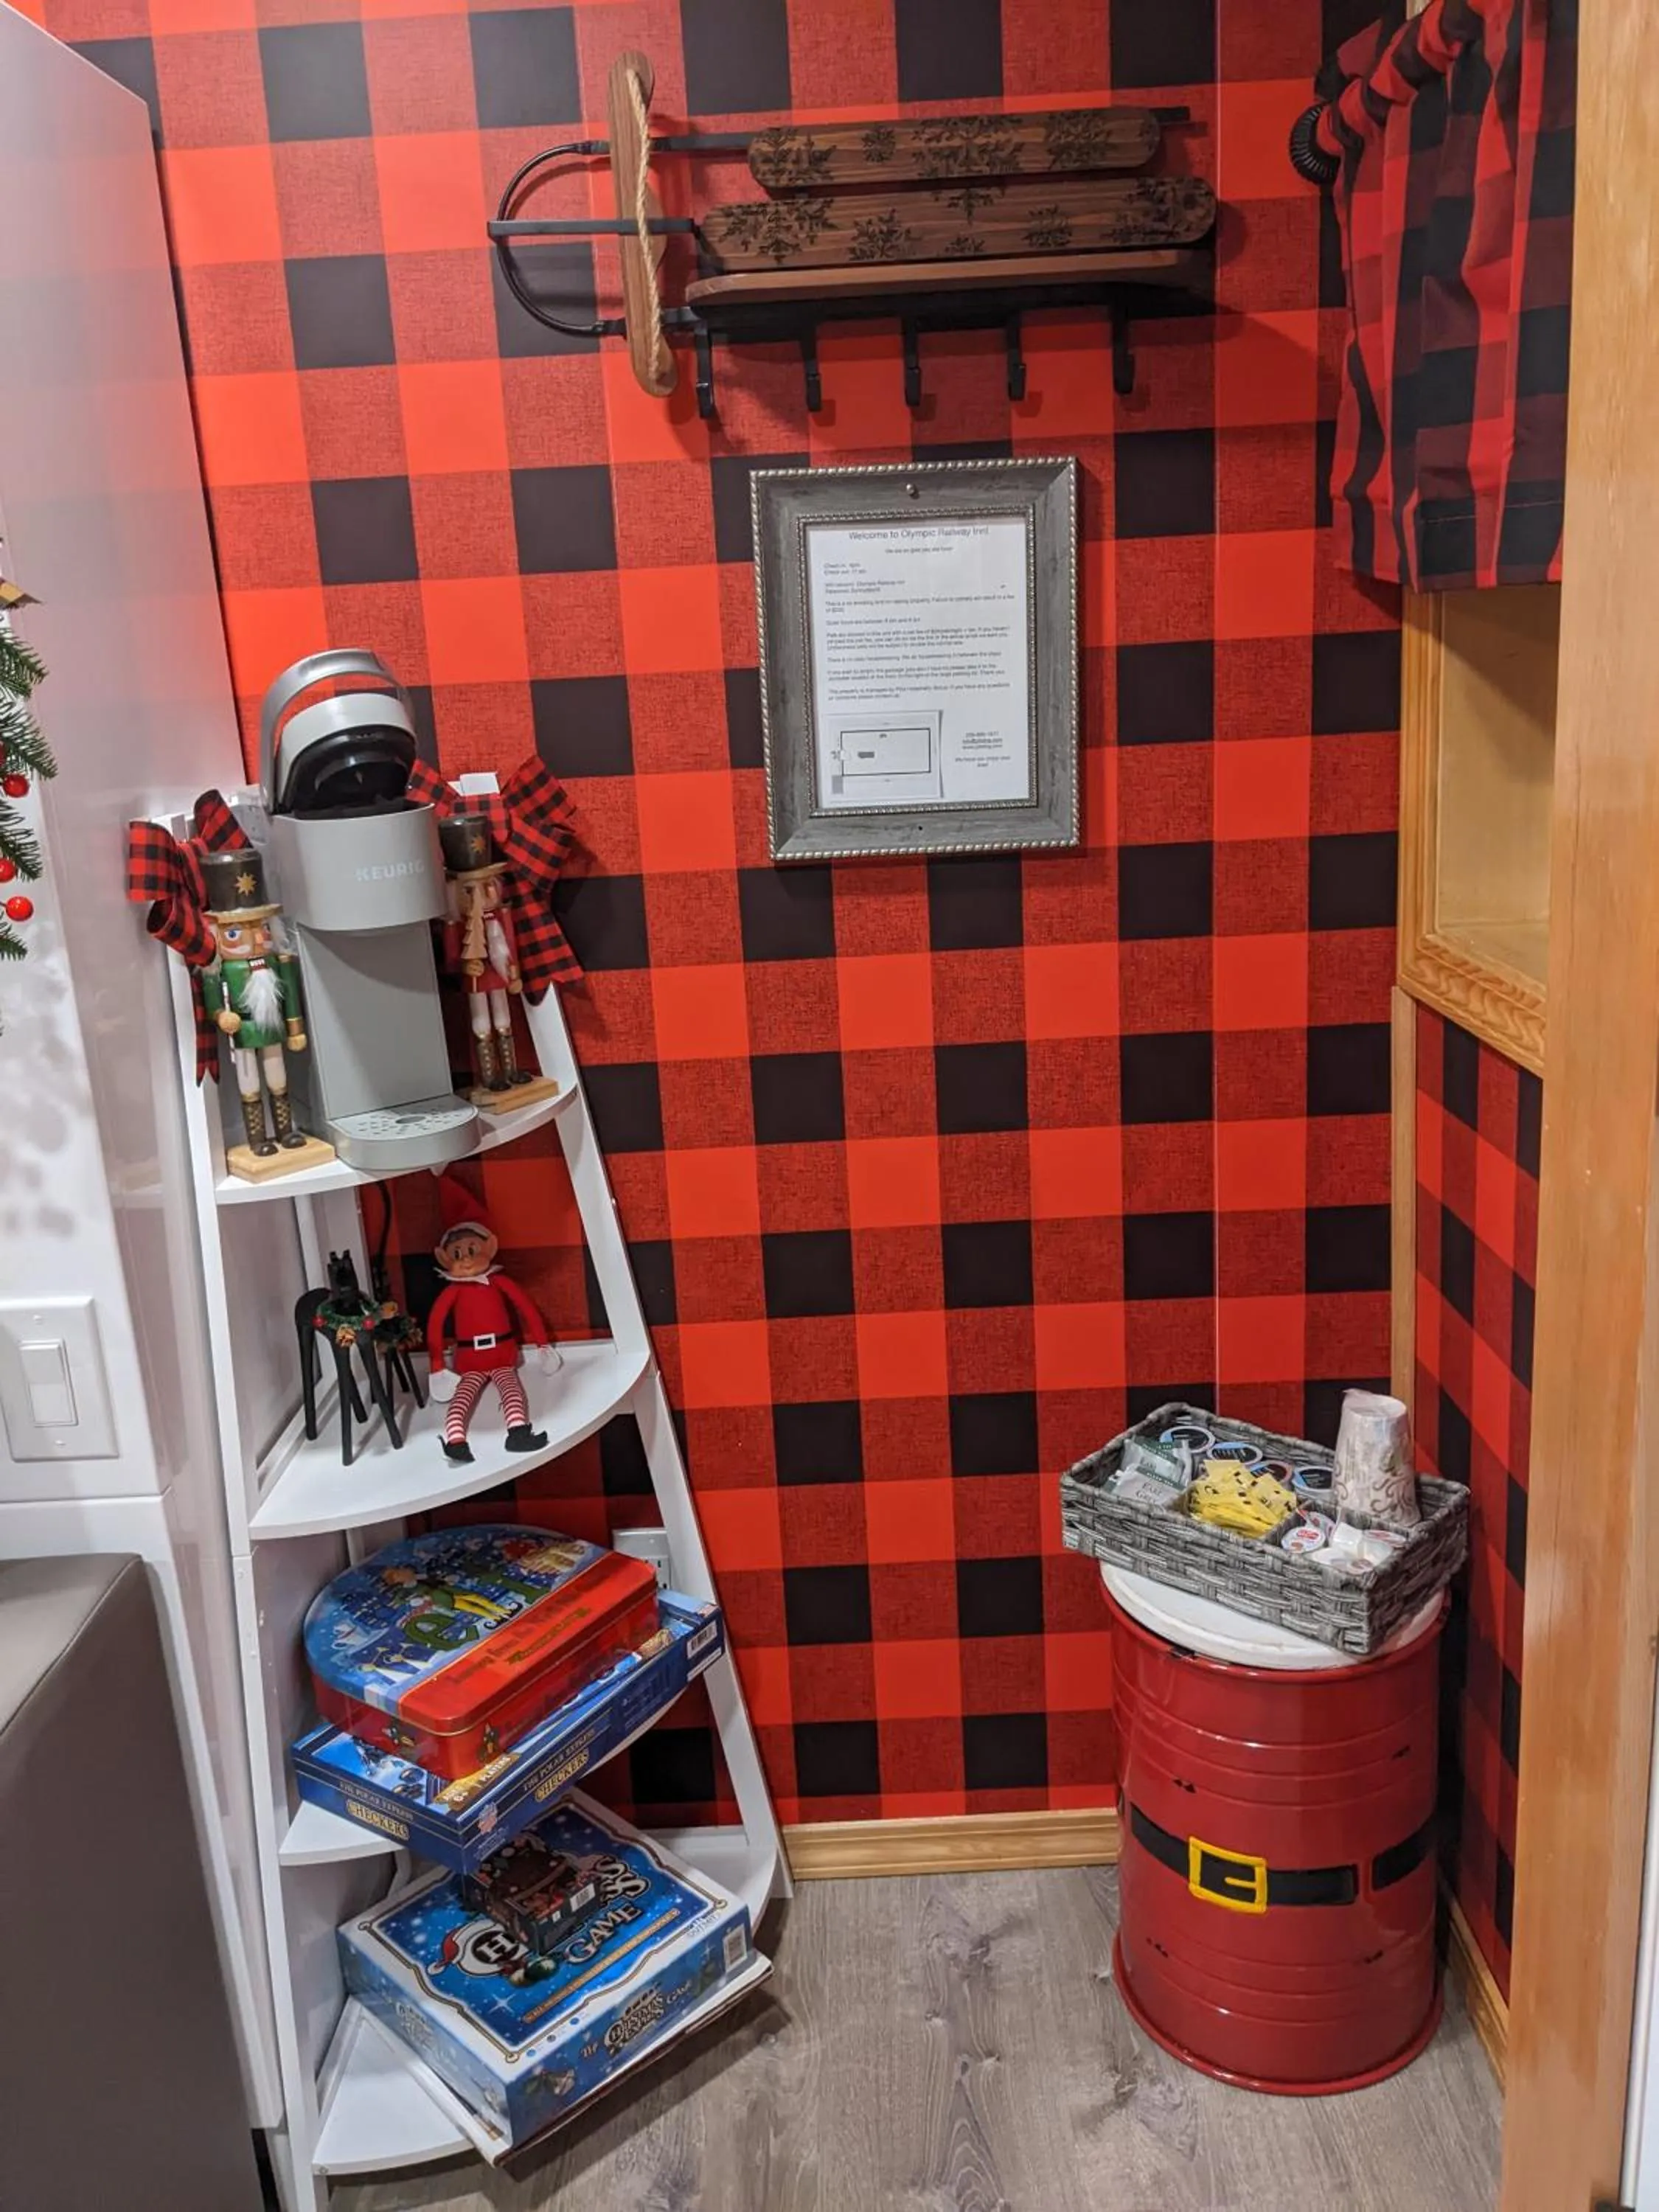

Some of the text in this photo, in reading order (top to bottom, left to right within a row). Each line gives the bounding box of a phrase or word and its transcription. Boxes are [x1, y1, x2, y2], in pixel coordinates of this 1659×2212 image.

[849, 531, 888, 540] Welcome
[890, 530, 898, 538] to
[901, 529, 936, 539] Olympic
[939, 526, 971, 538] Railway
[355, 859, 425, 882] KEURIG
[564, 1902, 643, 1964] GAME
